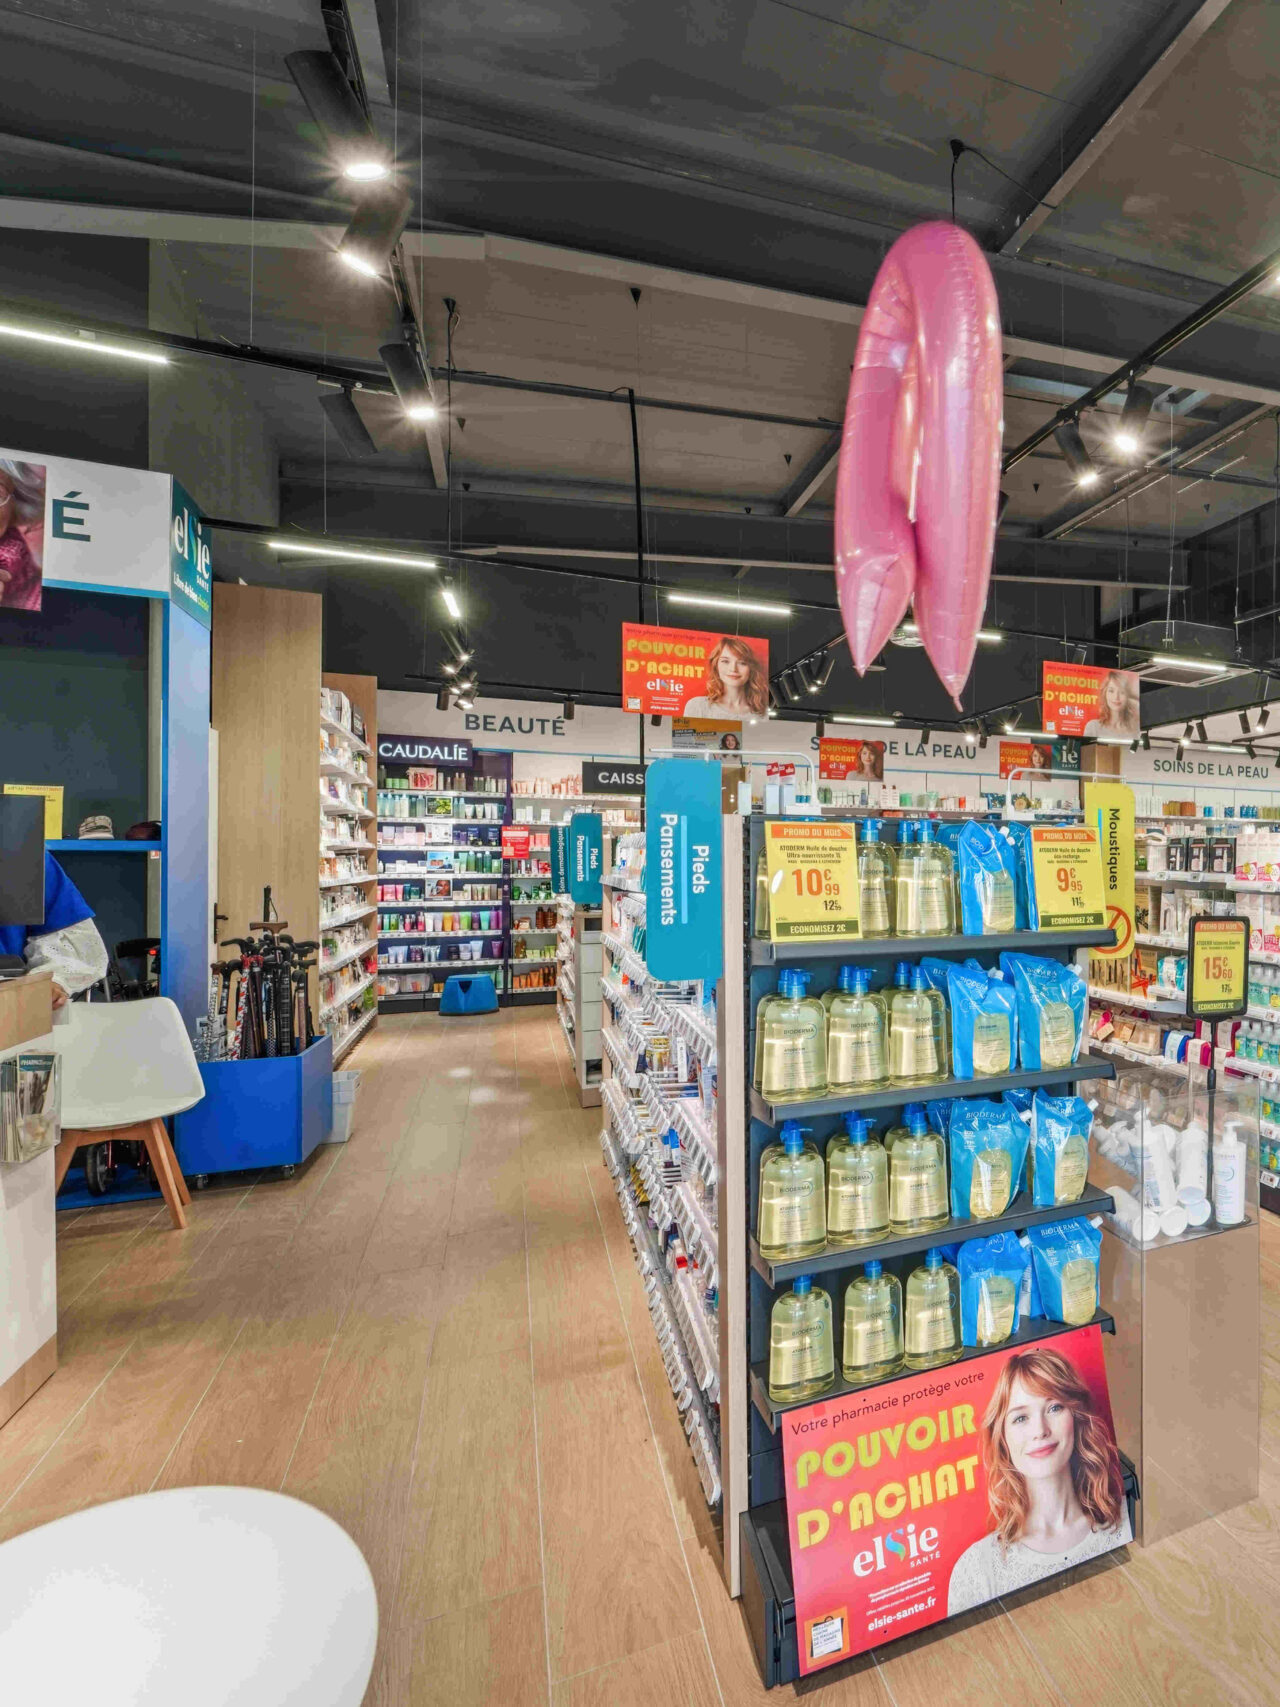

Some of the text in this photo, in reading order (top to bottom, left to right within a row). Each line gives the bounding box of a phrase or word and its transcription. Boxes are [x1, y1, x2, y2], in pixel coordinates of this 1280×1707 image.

[626, 639, 706, 659] POUVOIR
[625, 659, 705, 679] D'ACHAT
[646, 678, 684, 693] elsie
[1046, 674, 1099, 689] POUVOIR
[1045, 690, 1098, 705] D'ACHAT
[464, 713, 566, 737] BEAUTÉ
[905, 742, 927, 757] LA
[932, 744, 977, 760] PEAU
[1153, 759, 1269, 779] SOINS DE LA PEAU
[783, 827, 841, 836] PROMO DU MOIS
[577, 835, 585, 882] Pansements
[590, 848, 599, 869] Pieds
[1106, 808, 1120, 890] Moustiques
[660, 813, 678, 926] Pansements
[692, 845, 710, 894] Pieds
[790, 924, 846, 934] ECONOMISEZ 2€
[783, 1027, 815, 1036] BIODERMA
[791, 1371, 985, 1436] Votre pharmacie protège votre
[796, 1403, 977, 1489] POUVOIR
[797, 1455, 979, 1550] D'ACHAT
[852, 1523, 939, 1577] elsie
[910, 1551, 941, 1568] SANTÉ
[868, 1596, 937, 1631] elsie-sante.fr
